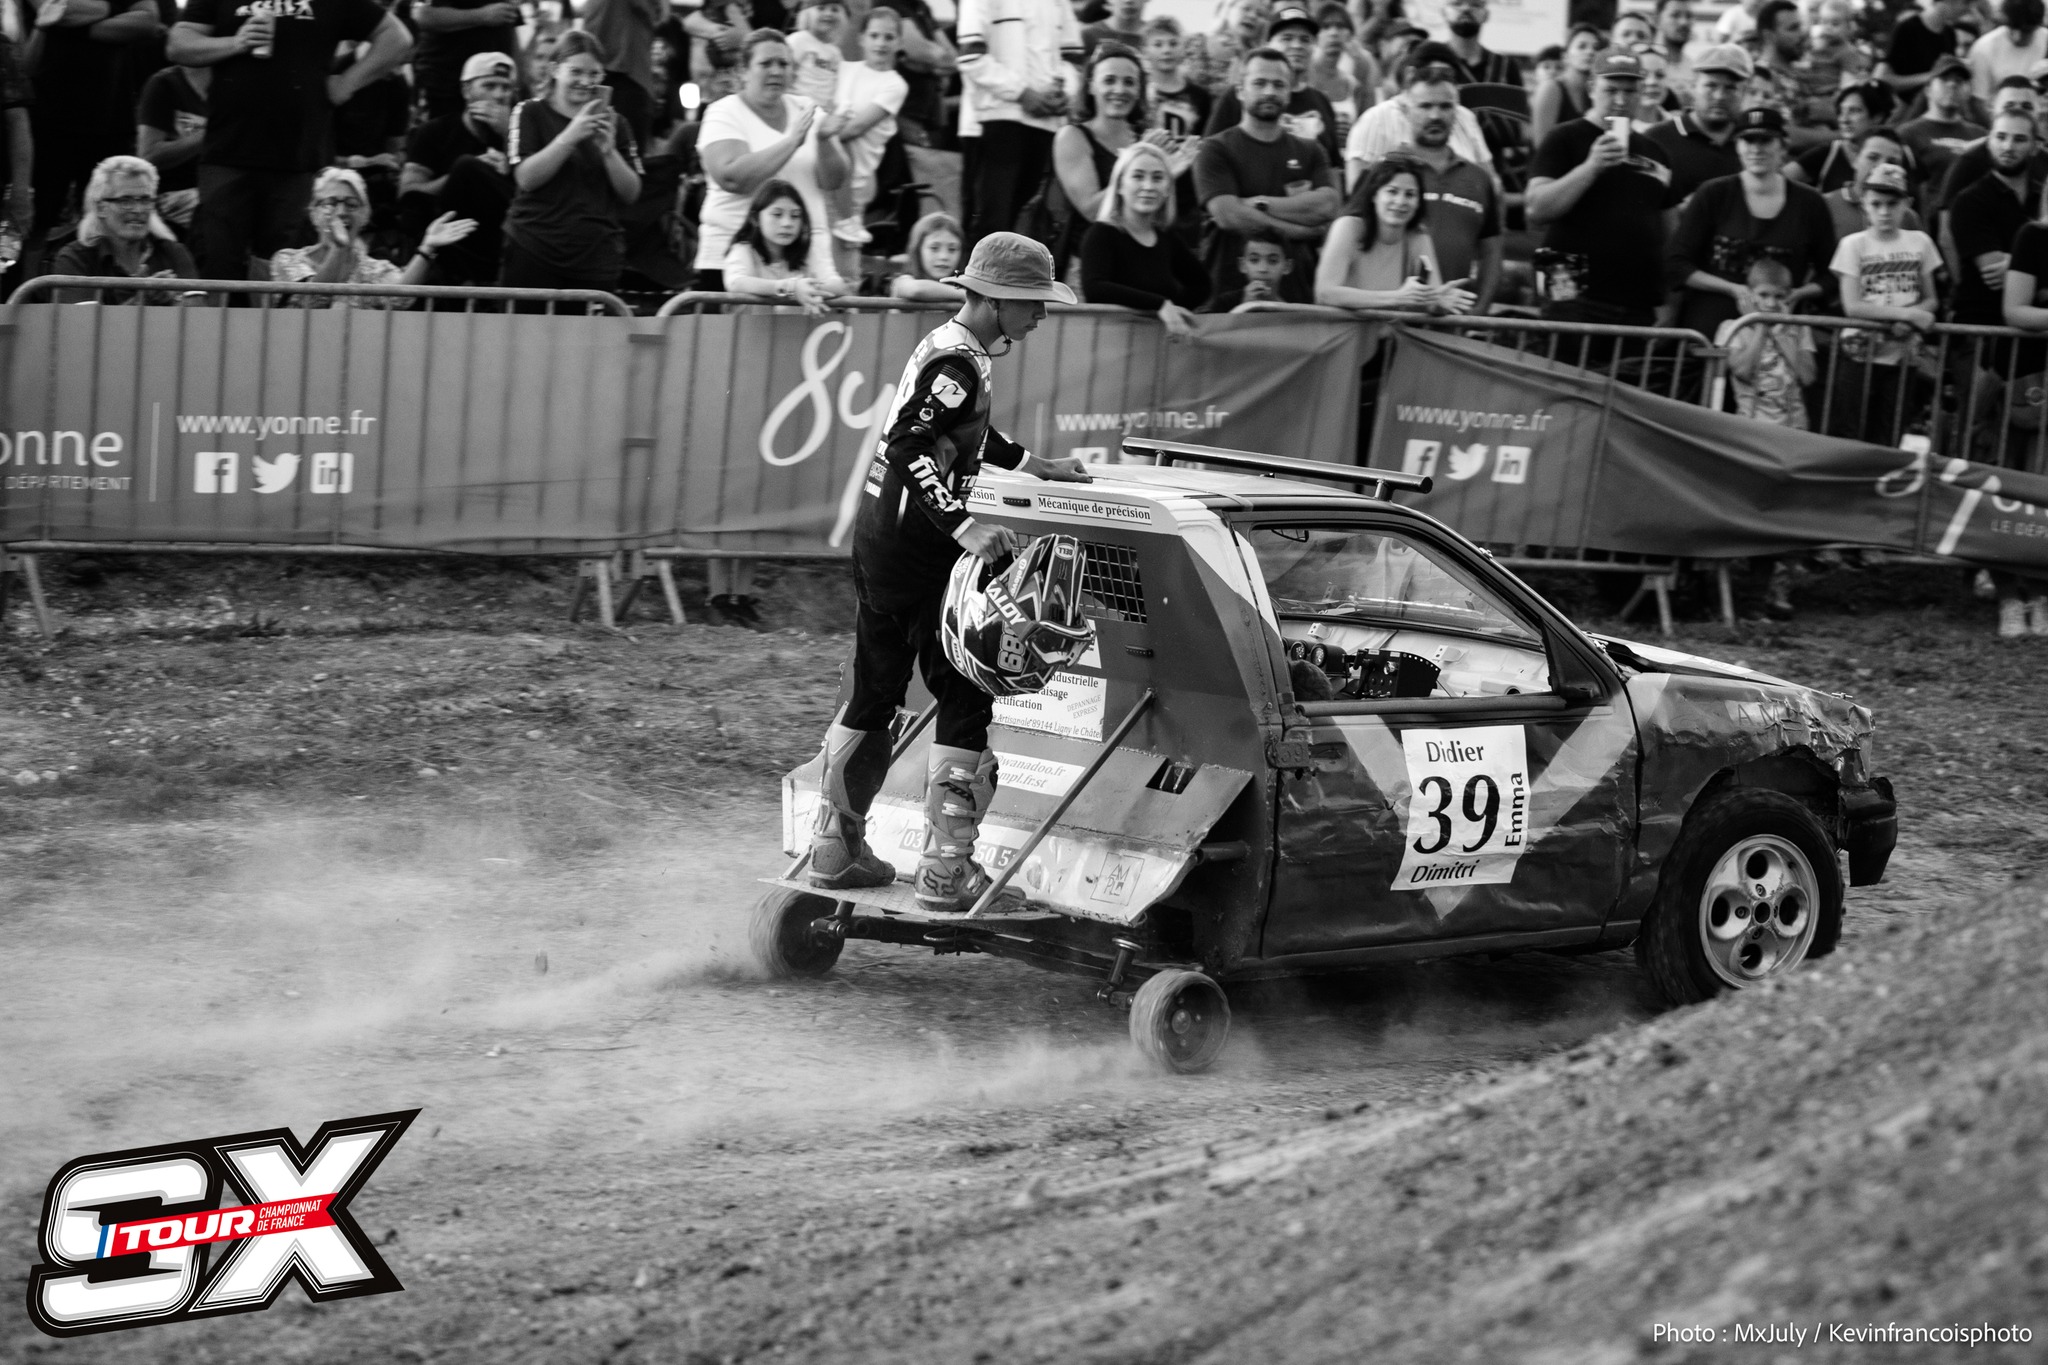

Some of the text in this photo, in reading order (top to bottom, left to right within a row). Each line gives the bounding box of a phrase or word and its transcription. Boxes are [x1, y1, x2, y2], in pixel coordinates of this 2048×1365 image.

[1055, 395, 1229, 436] www.yonne.fr
[1397, 394, 1553, 433] www.yonne.fr
[176, 410, 377, 441] www.yonne.fr
[1038, 497, 1151, 520] Mécanique de précision
[1050, 673, 1099, 688] ndustrielle
[994, 696, 1042, 711] ectification
[1067, 694, 1101, 712] DEPANNAGE
[1073, 705, 1098, 719] EXPRESS
[1031, 718, 1053, 731] 89144
[1425, 740, 1485, 764] Didier
[1413, 774, 1502, 855] 39
[1504, 772, 1525, 847] Emma
[998, 849, 1016, 867] 5
[1410, 859, 1481, 884] Dimitri
